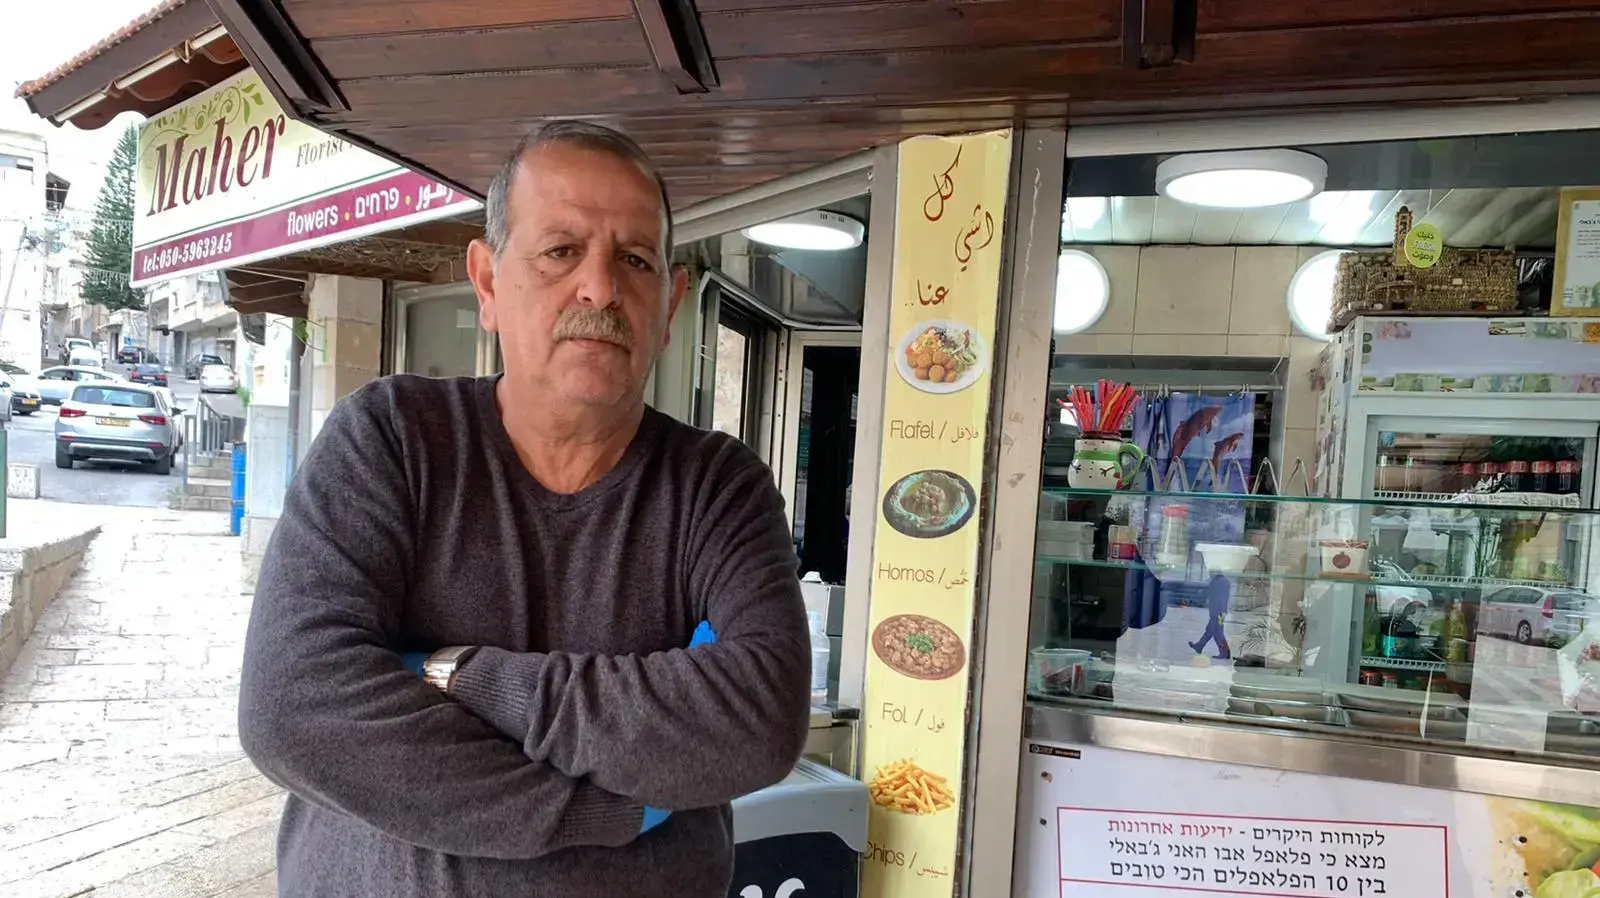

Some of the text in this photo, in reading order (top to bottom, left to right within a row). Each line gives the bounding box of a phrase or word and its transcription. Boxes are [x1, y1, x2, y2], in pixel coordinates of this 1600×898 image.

[296, 135, 344, 168] Florist
[146, 114, 286, 217] Maher
[287, 204, 339, 237] flowers
[355, 187, 400, 219] פרחים
[143, 231, 233, 274] tel:050-5963245
[889, 419, 936, 440] Flafel
[951, 425, 979, 443] فلافل
[878, 562, 935, 583] Homos
[882, 702, 907, 724] Fol
[927, 713, 945, 734] فول
[1108, 819, 1174, 835] אחרונות
[1180, 823, 1233, 838] ידיעות
[1253, 827, 1313, 845] היקרים
[1320, 829, 1386, 849] לקוחות
[1167, 843, 1207, 859] האני
[1213, 847, 1245, 861] אבו
[1252, 845, 1312, 865] פלאפל
[1319, 852, 1337, 867] כי
[1344, 854, 1386, 870] מצא
[1110, 861, 1387, 897] בין 10 הפלאפלים הכי טובים
